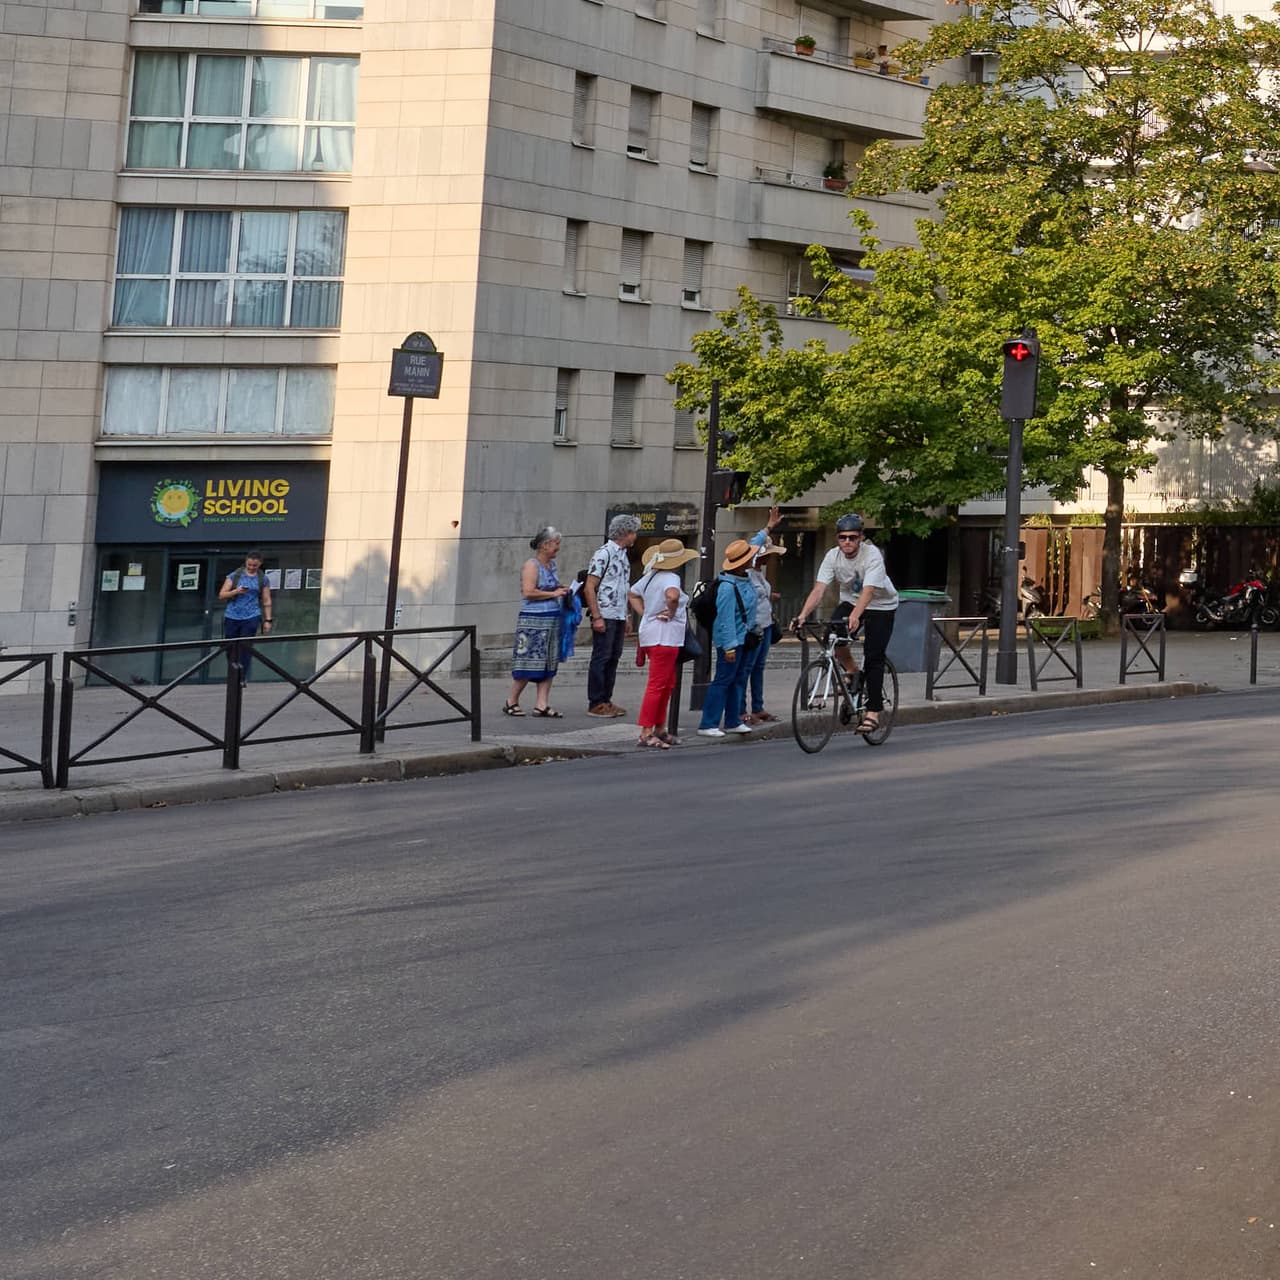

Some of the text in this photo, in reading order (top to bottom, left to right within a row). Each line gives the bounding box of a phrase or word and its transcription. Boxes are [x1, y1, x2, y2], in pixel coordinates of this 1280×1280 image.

[409, 355, 427, 366] RUE
[403, 366, 431, 377] MANIN
[206, 479, 290, 497] LIVING
[203, 499, 289, 515] SCHOOL
